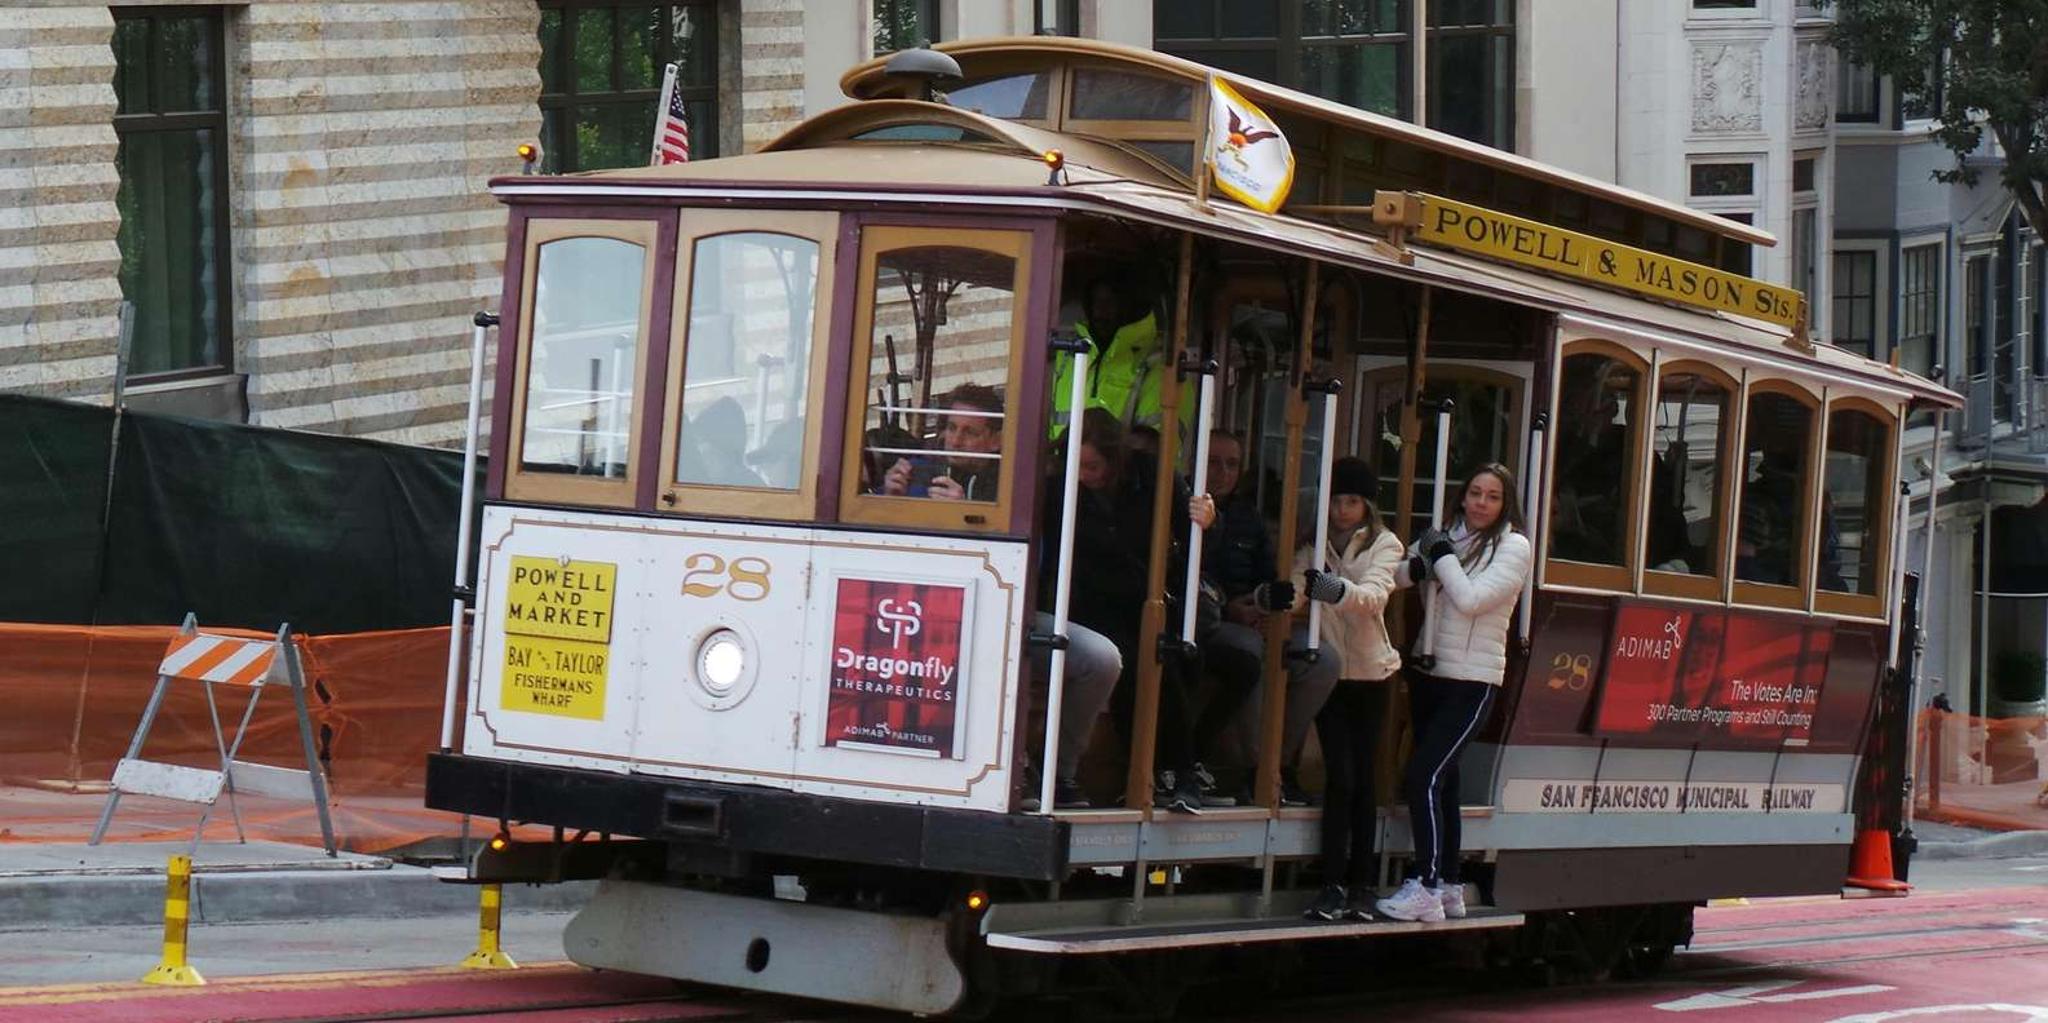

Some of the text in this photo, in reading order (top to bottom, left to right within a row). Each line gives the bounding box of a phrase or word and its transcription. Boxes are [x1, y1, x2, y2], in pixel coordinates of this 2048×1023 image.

[1434, 207, 1794, 319] POWELL & MASON Sts.
[515, 567, 606, 592] POWELL
[681, 553, 771, 601] 28
[537, 592, 582, 605] AND
[509, 604, 606, 628] MARKET
[1616, 636, 1673, 660] ADIMAB
[508, 647, 532, 668] BAY
[555, 651, 605, 675] TAYLOR
[837, 647, 954, 685] Dragonfly
[1548, 653, 1591, 690] 28
[514, 674, 593, 694] FISHERMANS
[836, 678, 952, 701] THERAPEUTICS
[1731, 680, 1818, 704] The Votes Are In:
[532, 694, 573, 708] WHARF
[1647, 704, 1812, 729] 300 Partner Programs and Still Counting
[843, 725, 936, 743] ADIMAB PARTNER
[1541, 784, 1575, 807] SAN
[1761, 788, 1815, 809] RAILWAY
